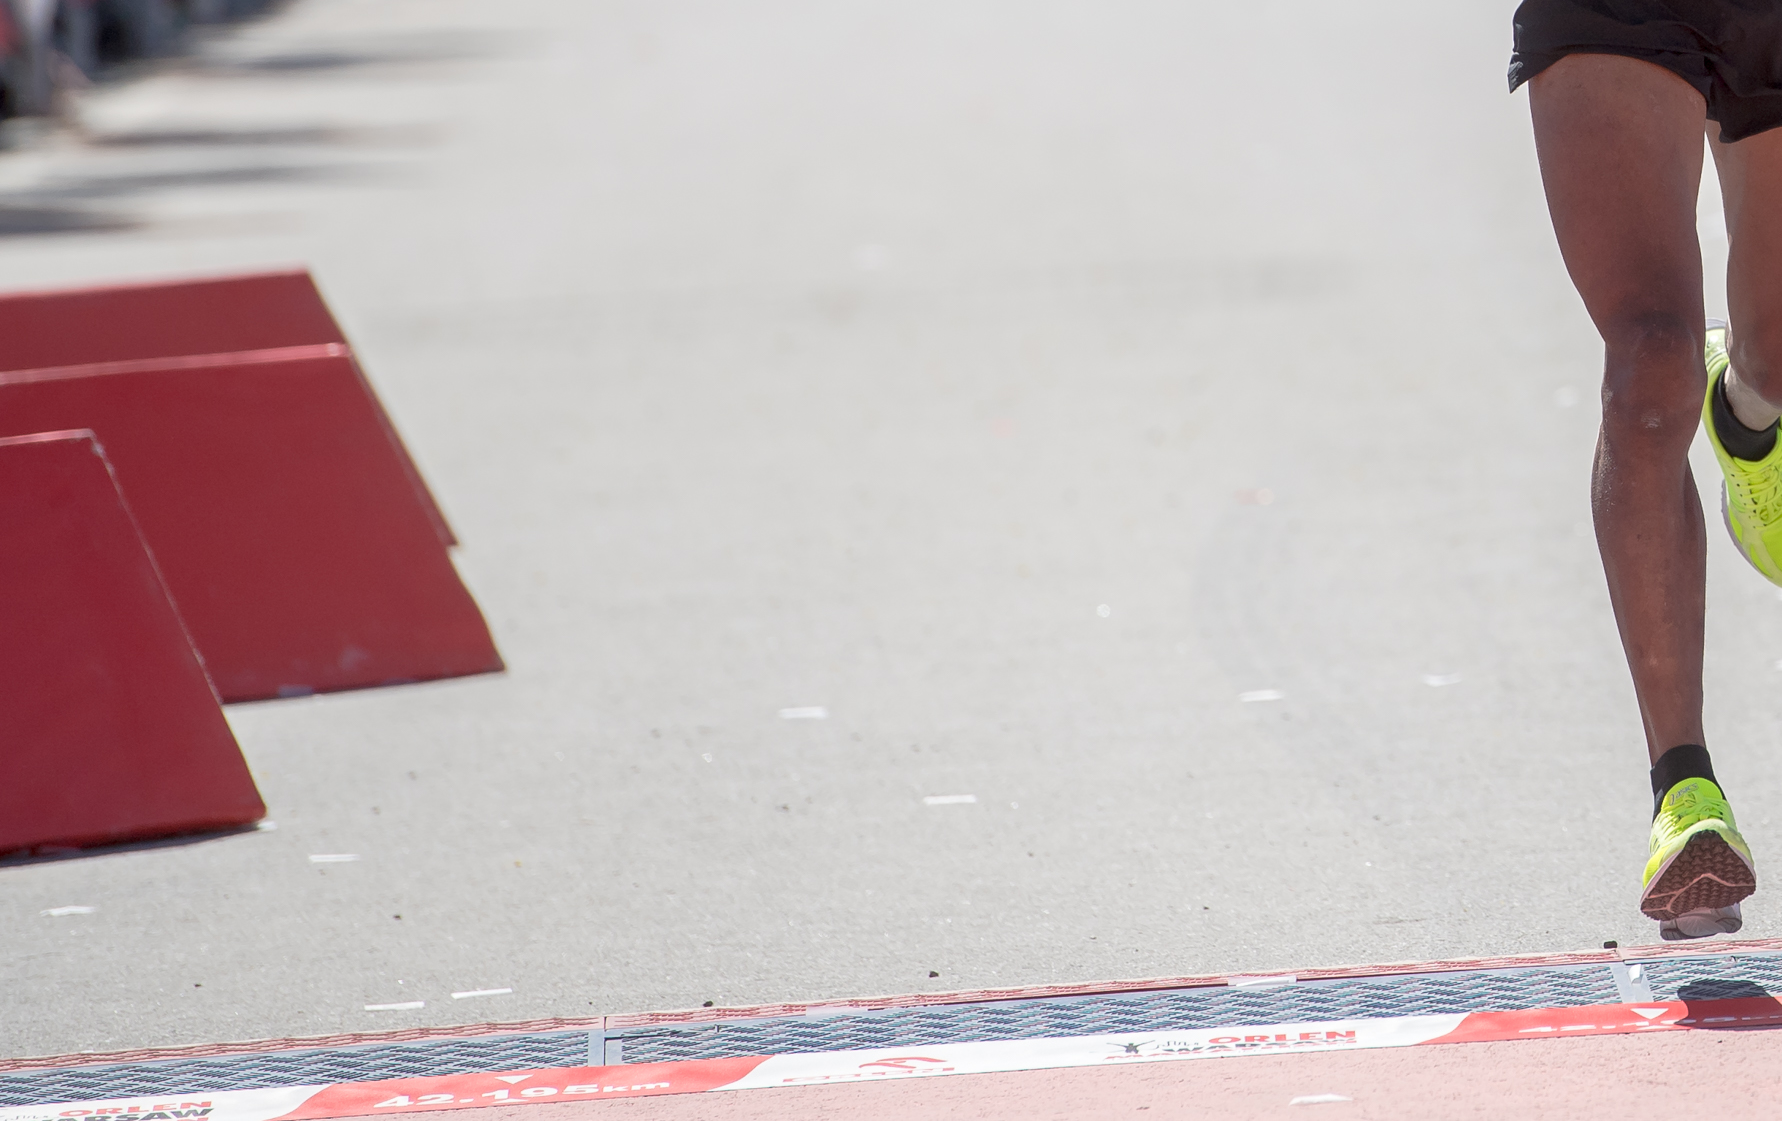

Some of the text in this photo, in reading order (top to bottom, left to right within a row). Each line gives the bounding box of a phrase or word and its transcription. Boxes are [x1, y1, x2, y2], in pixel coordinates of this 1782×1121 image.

[1208, 1030, 1357, 1044] ORLEN
[373, 1081, 670, 1109] 42.195km
[58, 1100, 212, 1117] ORLEN
